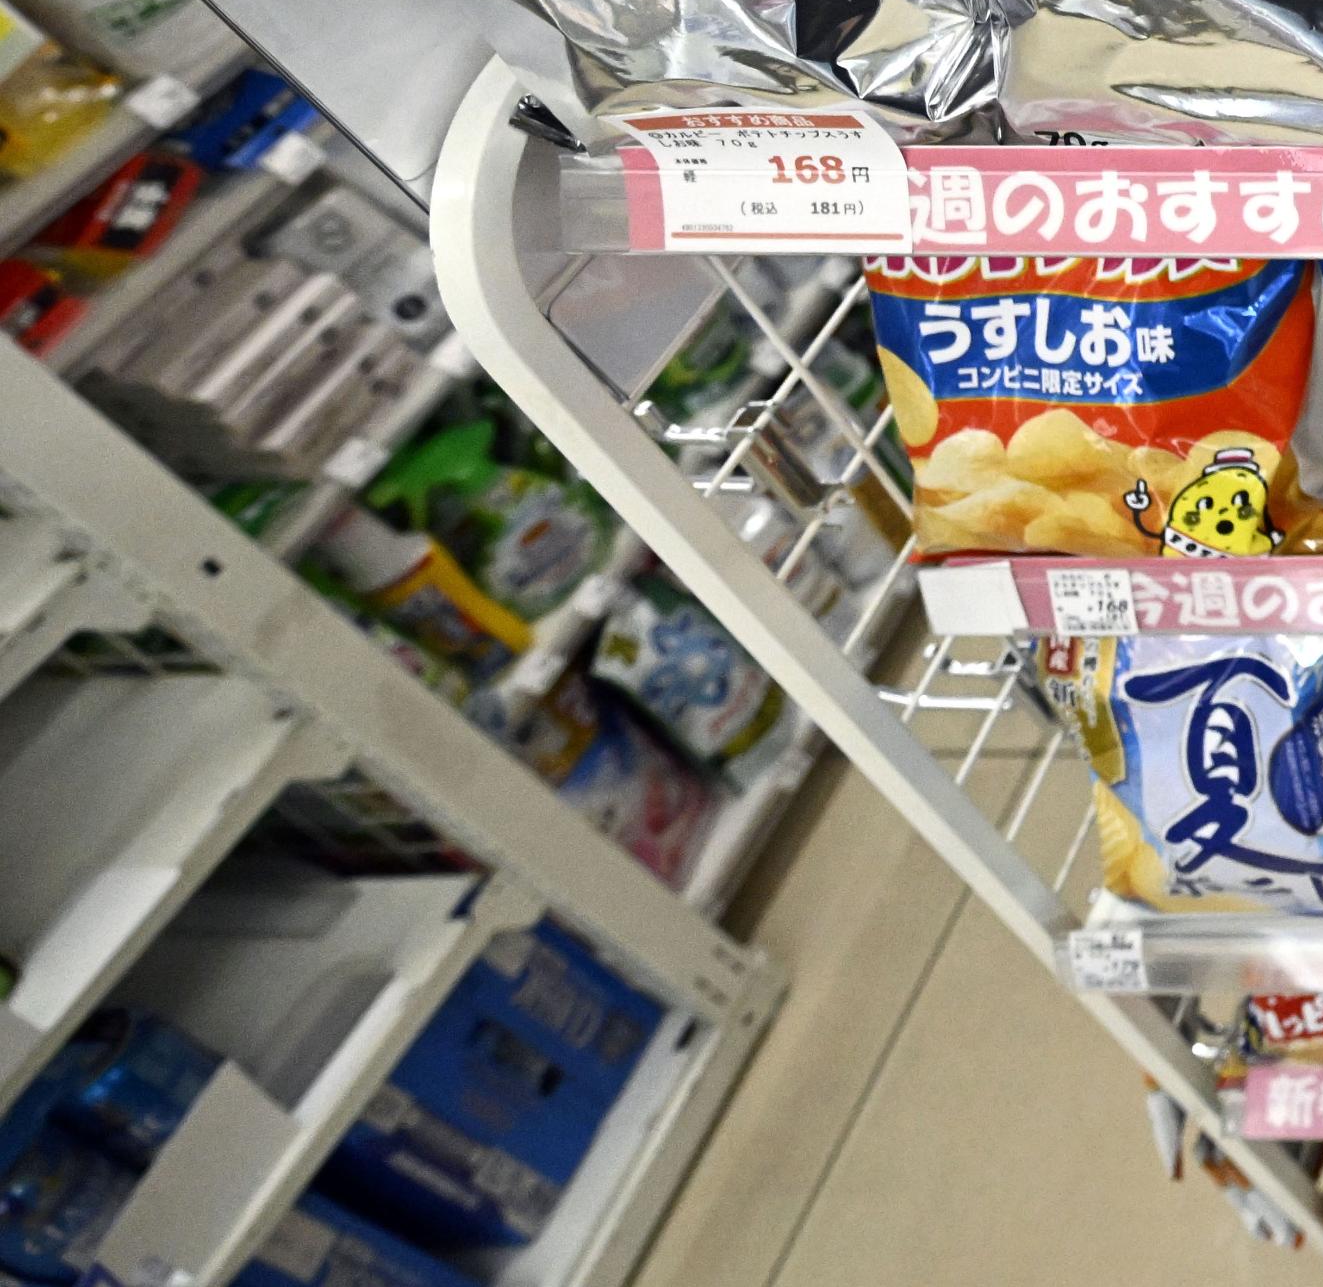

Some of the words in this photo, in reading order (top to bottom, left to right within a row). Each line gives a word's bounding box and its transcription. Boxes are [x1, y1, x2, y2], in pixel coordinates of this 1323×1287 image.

[681, 114, 815, 128] おすすめ商品
[917, 294, 1177, 368] うすしお味
[957, 364, 1144, 397] コンビニ限定サイズ
